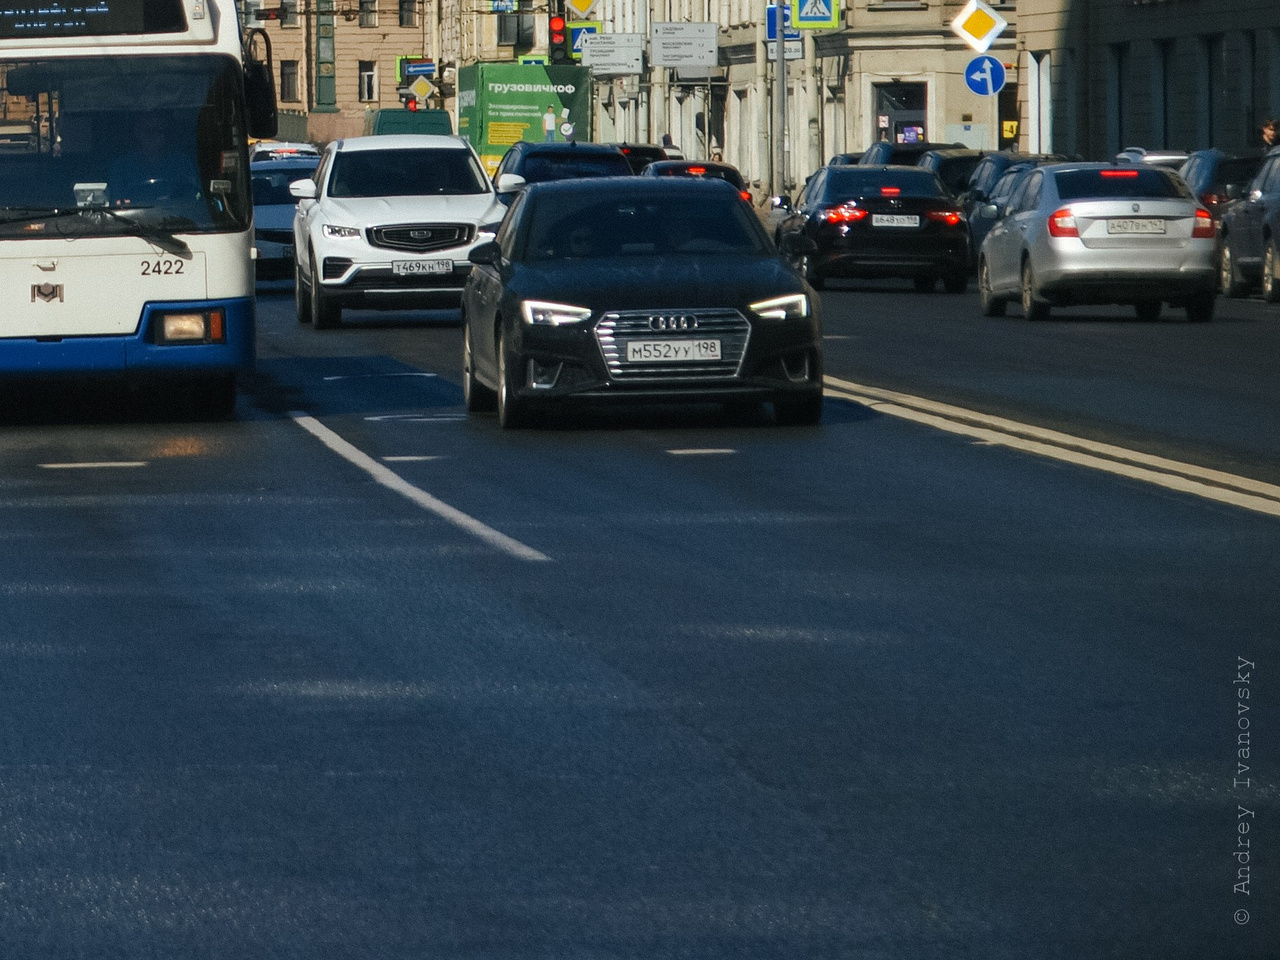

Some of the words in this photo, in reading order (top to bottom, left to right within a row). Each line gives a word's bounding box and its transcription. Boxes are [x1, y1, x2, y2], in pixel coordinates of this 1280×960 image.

[488, 83, 576, 94] грузовичкоф
[140, 260, 185, 276] 2422
[396, 262, 435, 272] Т469КН
[436, 260, 451, 269] 198
[632, 344, 690, 359] М552УУ
[695, 341, 717, 353] 198
